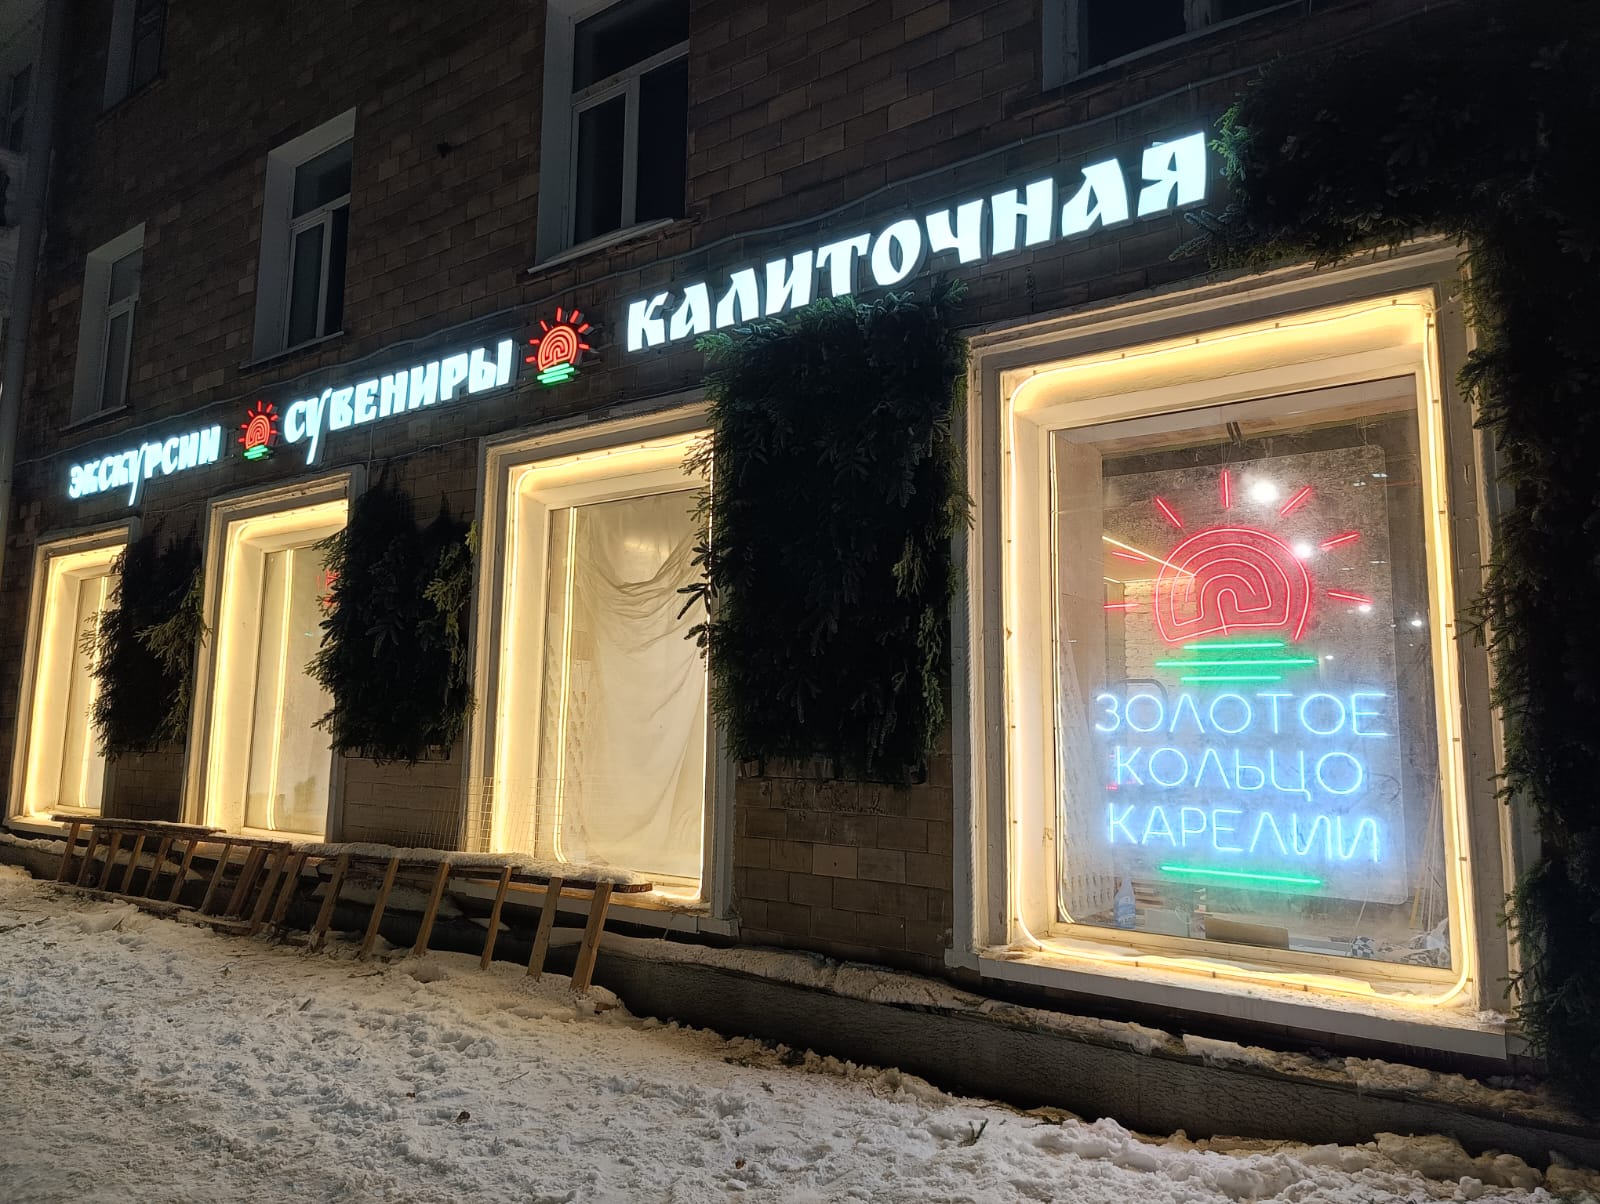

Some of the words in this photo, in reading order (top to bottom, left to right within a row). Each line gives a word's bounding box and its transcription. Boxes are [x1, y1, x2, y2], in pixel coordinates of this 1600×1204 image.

[69, 425, 221, 505] ЭКСКУРСИИ
[284, 339, 514, 464] СУВЕНИРЫ
[626, 131, 1207, 352] КАЛИТОЧНАЯ
[1094, 692, 1389, 737] ЗОЛОТОЕ
[1114, 745, 1364, 801] КОЛЬЦО
[1108, 802, 1379, 863] КАРЕЛИИ
